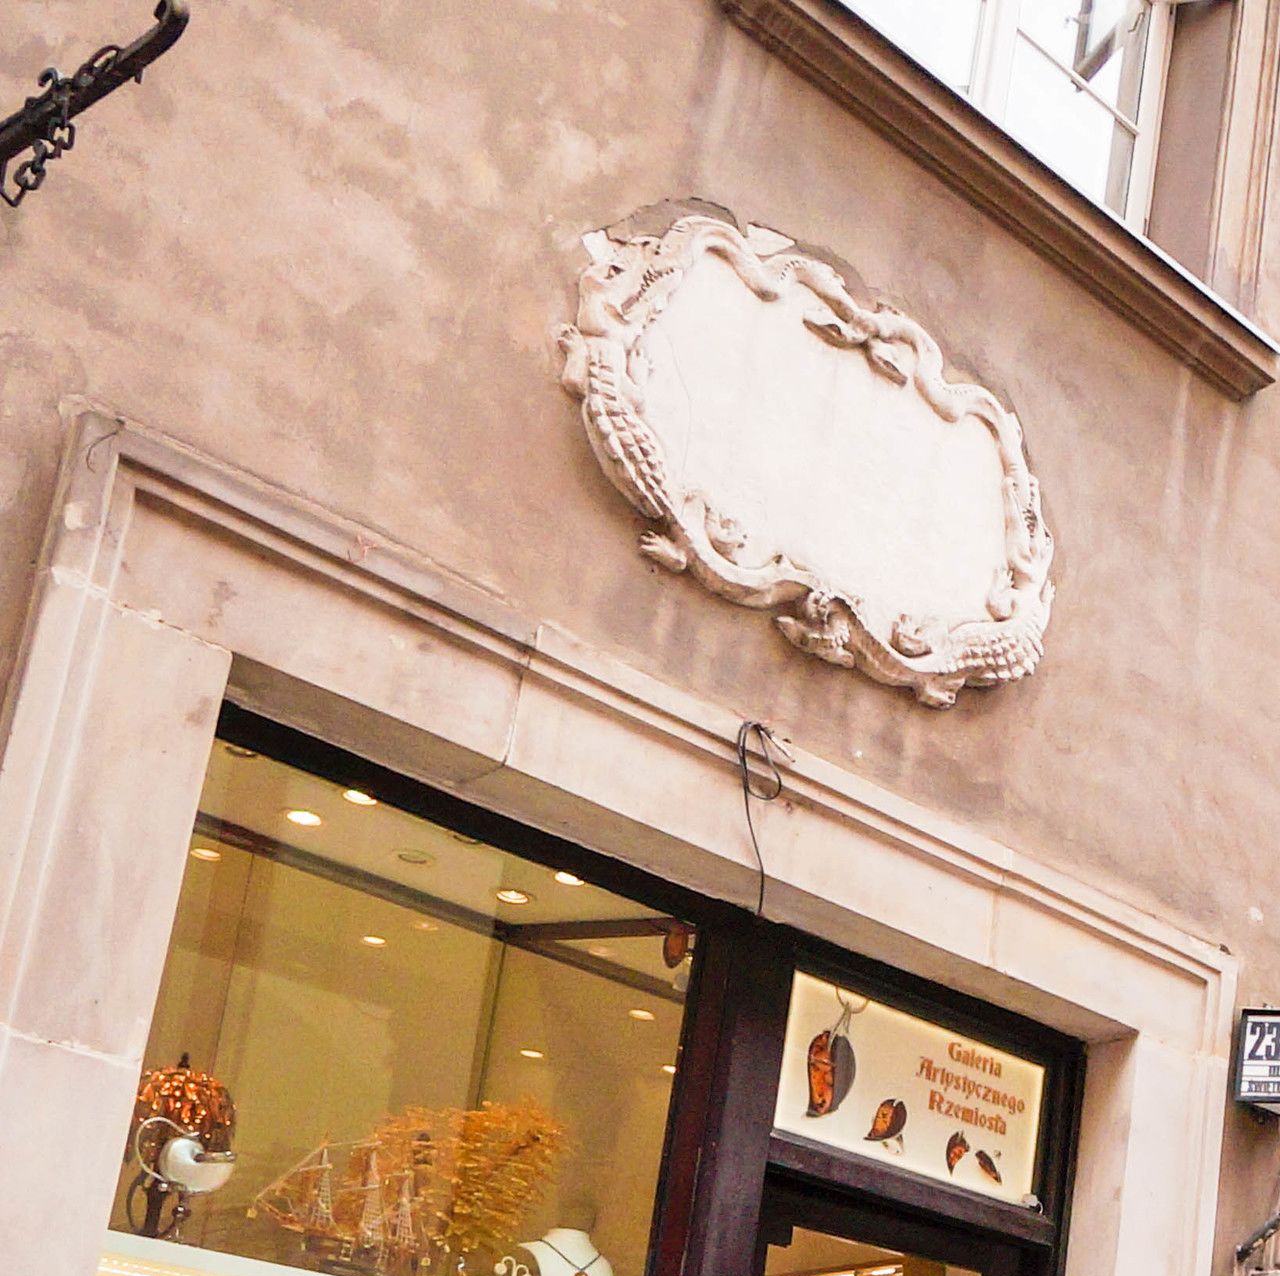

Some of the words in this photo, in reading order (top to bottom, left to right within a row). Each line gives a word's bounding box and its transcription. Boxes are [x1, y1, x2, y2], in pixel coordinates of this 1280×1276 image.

[915, 1055, 1025, 1114] Artystycznego
[947, 1042, 1003, 1079] Galeria
[928, 1088, 1008, 1136] Rzemiosła
